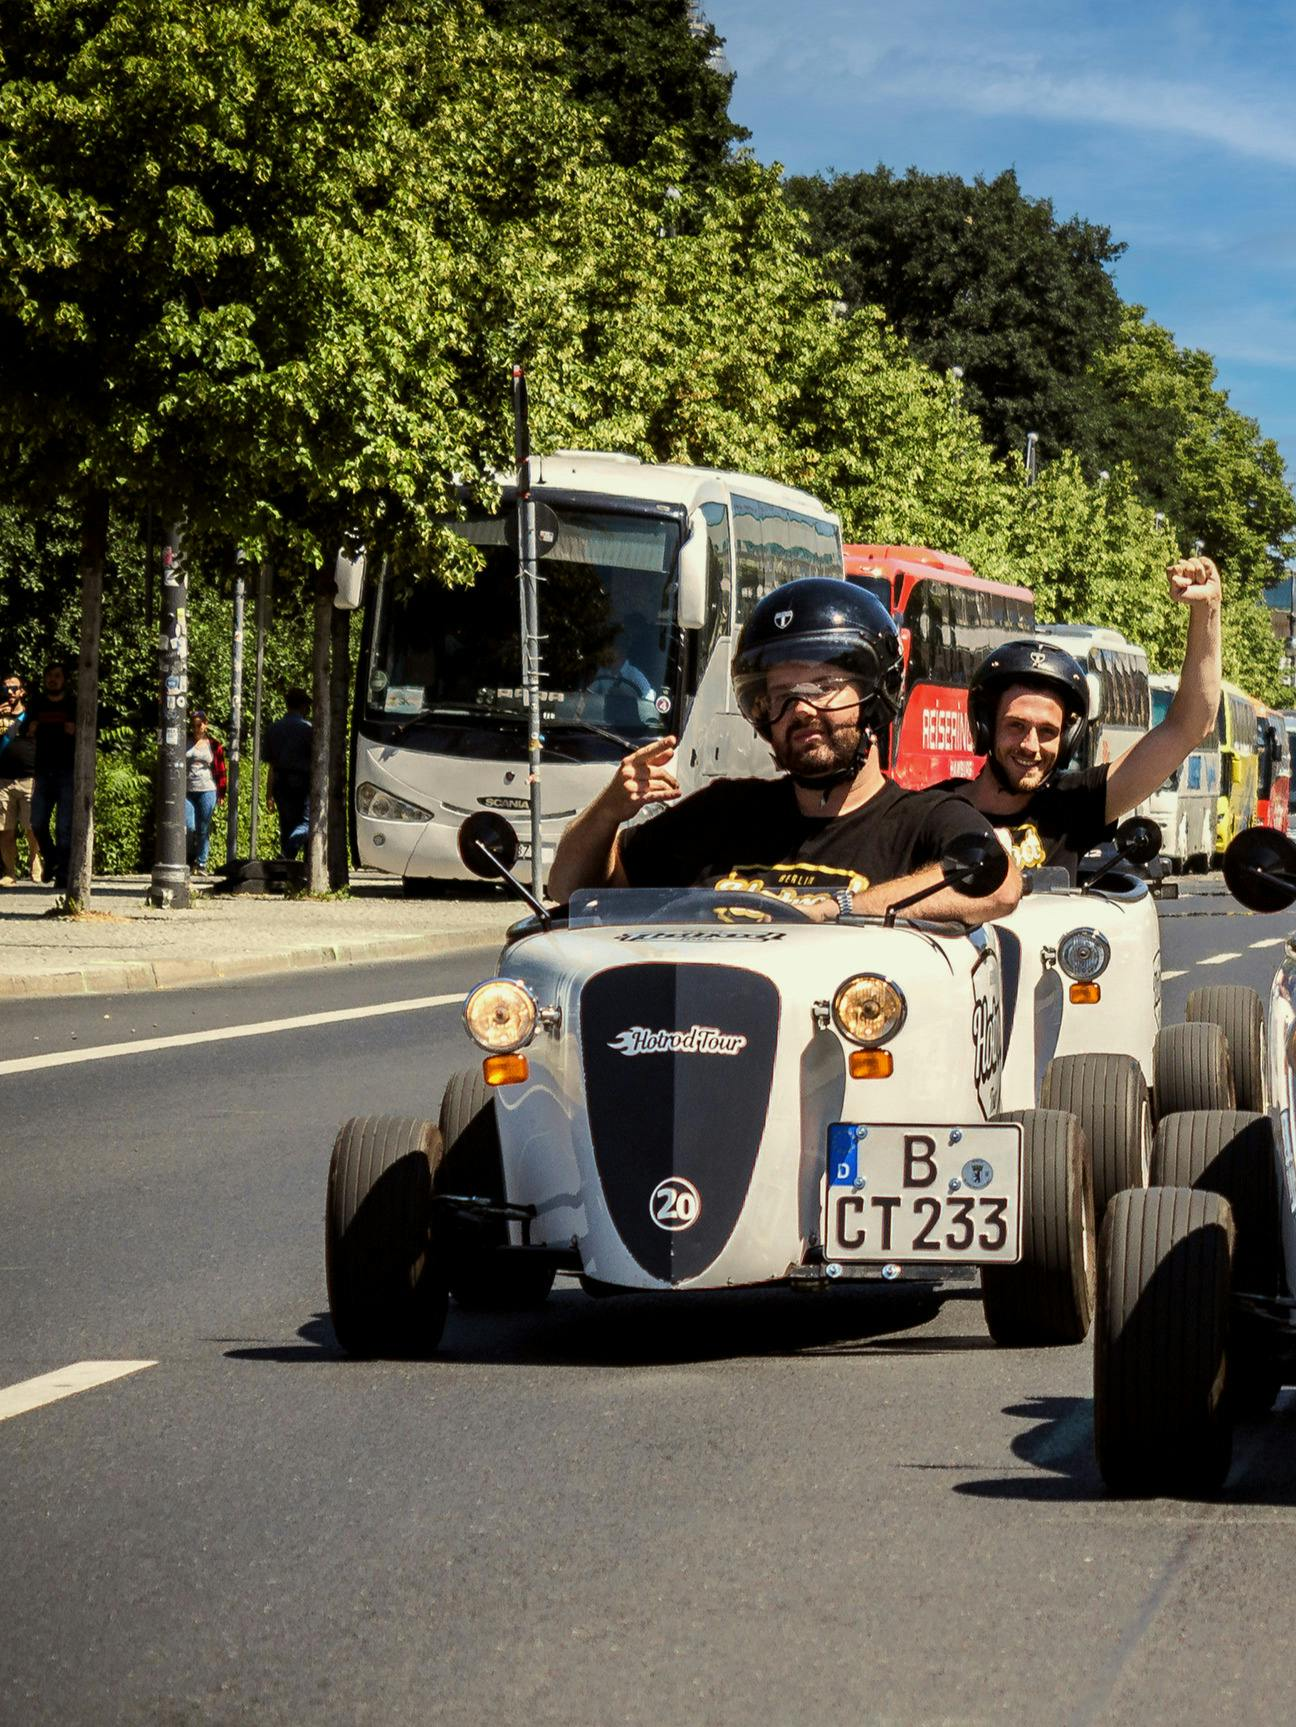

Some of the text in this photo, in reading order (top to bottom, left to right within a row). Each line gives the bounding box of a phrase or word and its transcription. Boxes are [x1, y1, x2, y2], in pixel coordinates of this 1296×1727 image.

[485, 798, 530, 809] SCANIA
[778, 873, 816, 886] BERLIN
[837, 1163, 850, 1179] D
[902, 1135, 938, 1188] B
[656, 1187, 697, 1221] 20
[836, 1195, 1008, 1251] CT 233
